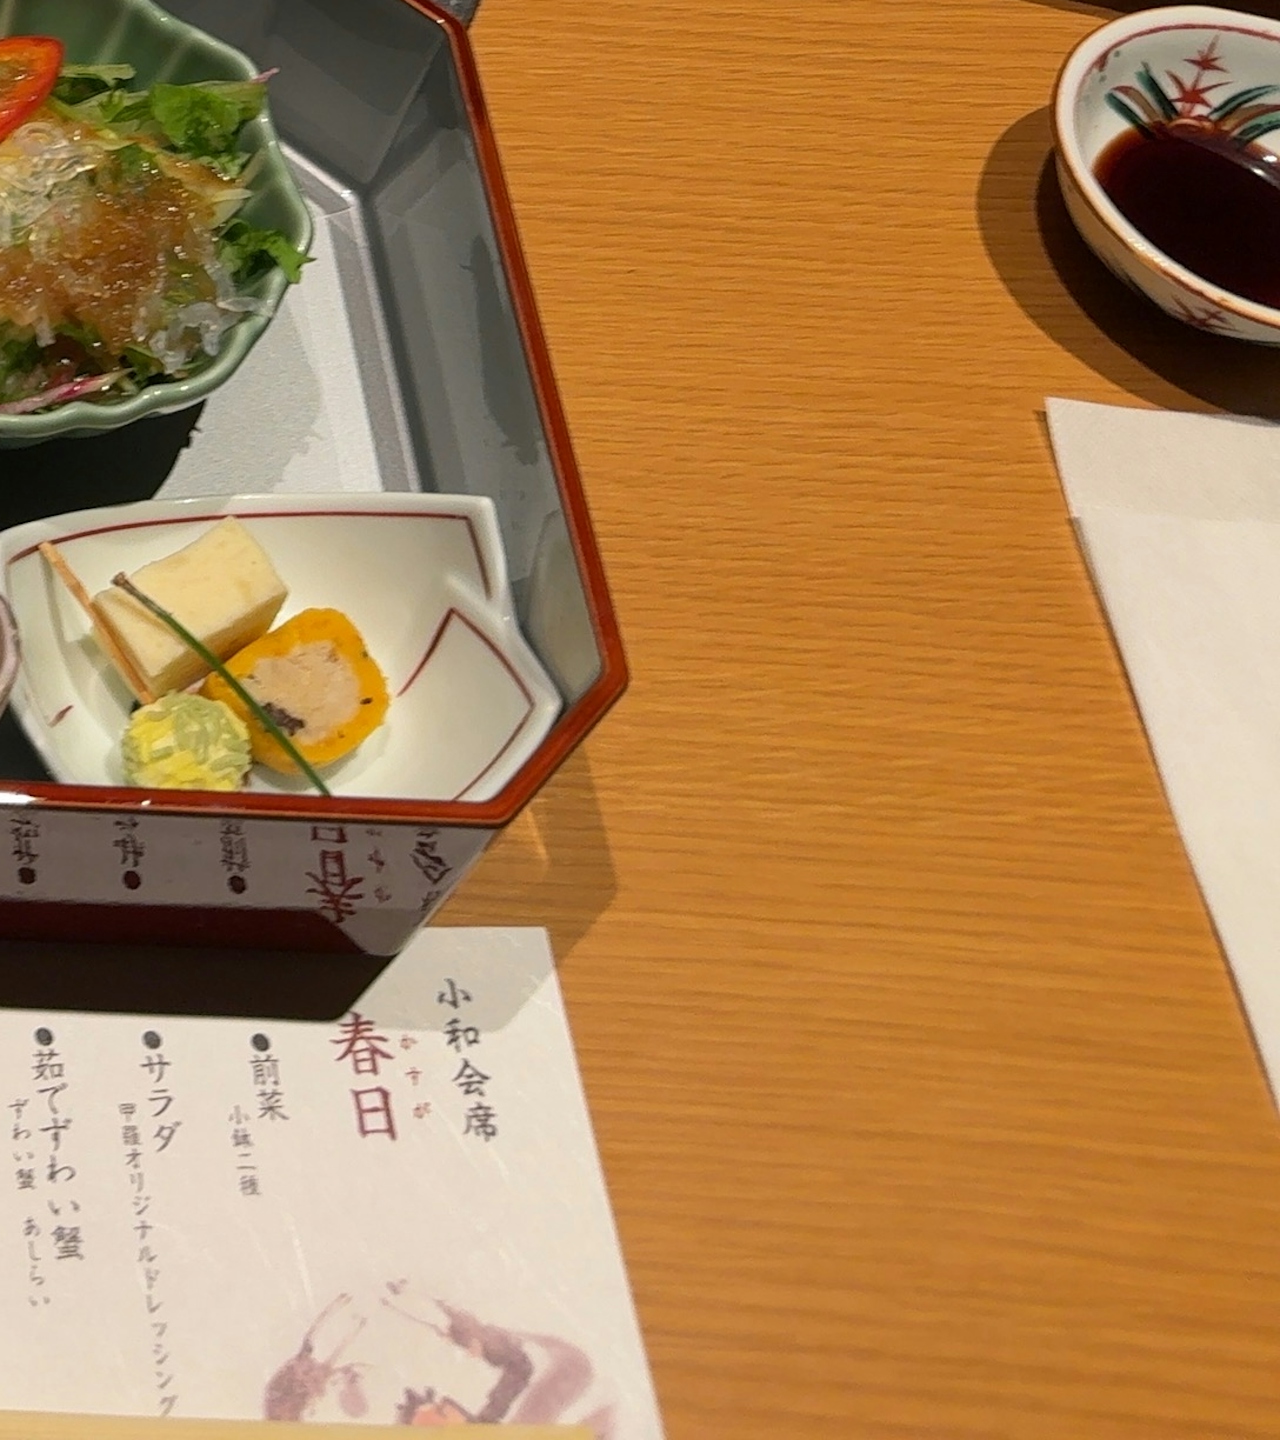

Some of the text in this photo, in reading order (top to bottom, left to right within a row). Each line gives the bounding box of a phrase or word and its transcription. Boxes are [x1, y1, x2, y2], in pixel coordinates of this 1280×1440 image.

[139, 1052, 183, 1154] サラダ
[249, 1053, 290, 1122] 前菜
[328, 1011, 399, 1141] 春日
[397, 1034, 432, 1120] かすが
[436, 978, 500, 1143] 小和会席
[6, 1098, 51, 1308] ずわい蟹 あしらい
[31, 1050, 85, 1262] 茹でずわい蟹
